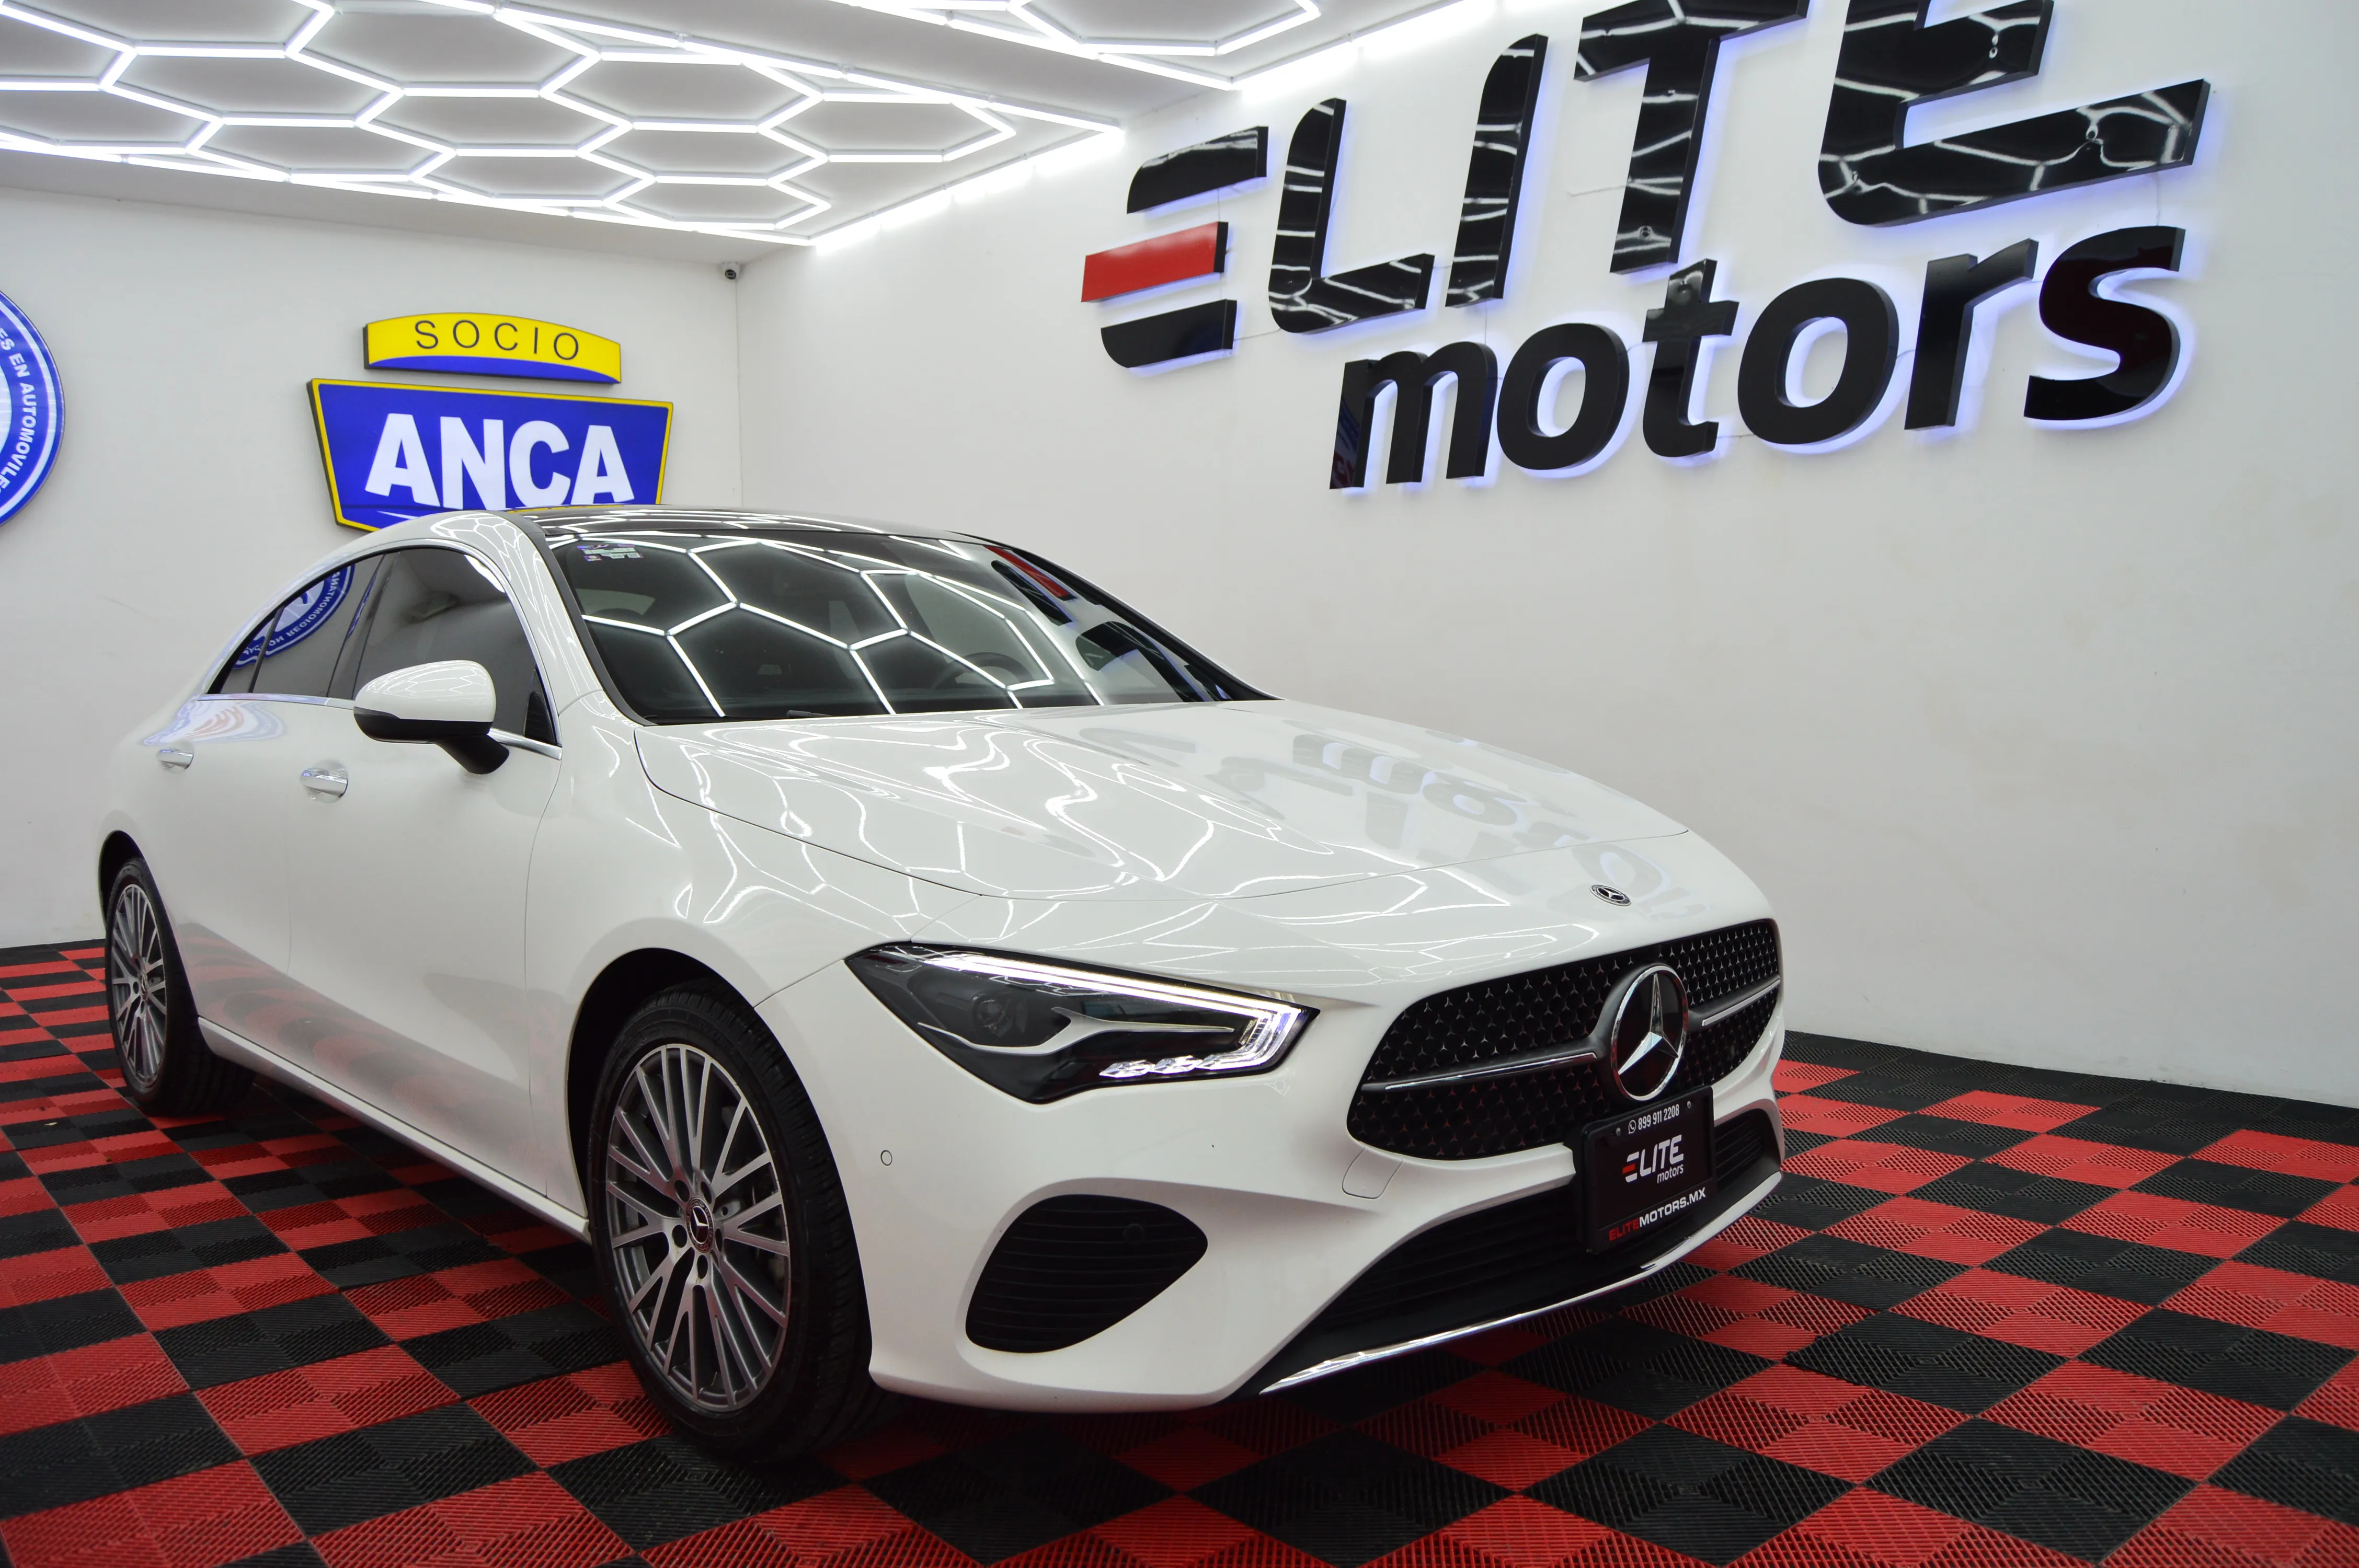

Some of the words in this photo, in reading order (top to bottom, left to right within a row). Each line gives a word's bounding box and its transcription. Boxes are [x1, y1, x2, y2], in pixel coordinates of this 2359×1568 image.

[1081, 0, 2211, 368] ELITE
[414, 319, 579, 360] SOCIO
[1330, 225, 2185, 489] motors
[8, 353, 30, 378] EN
[0, 382, 37, 494] AUTOMOVILE
[364, 413, 634, 510] ANCA
[1638, 1114, 1652, 1131] 899
[1653, 1110, 1662, 1125] 911
[1664, 1103, 1679, 1121] 2208
[1622, 1134, 1684, 1183] ELITE
[1656, 1163, 1684, 1184] motors
[1609, 1187, 1706, 1241] ELITEMOTORS.MX
